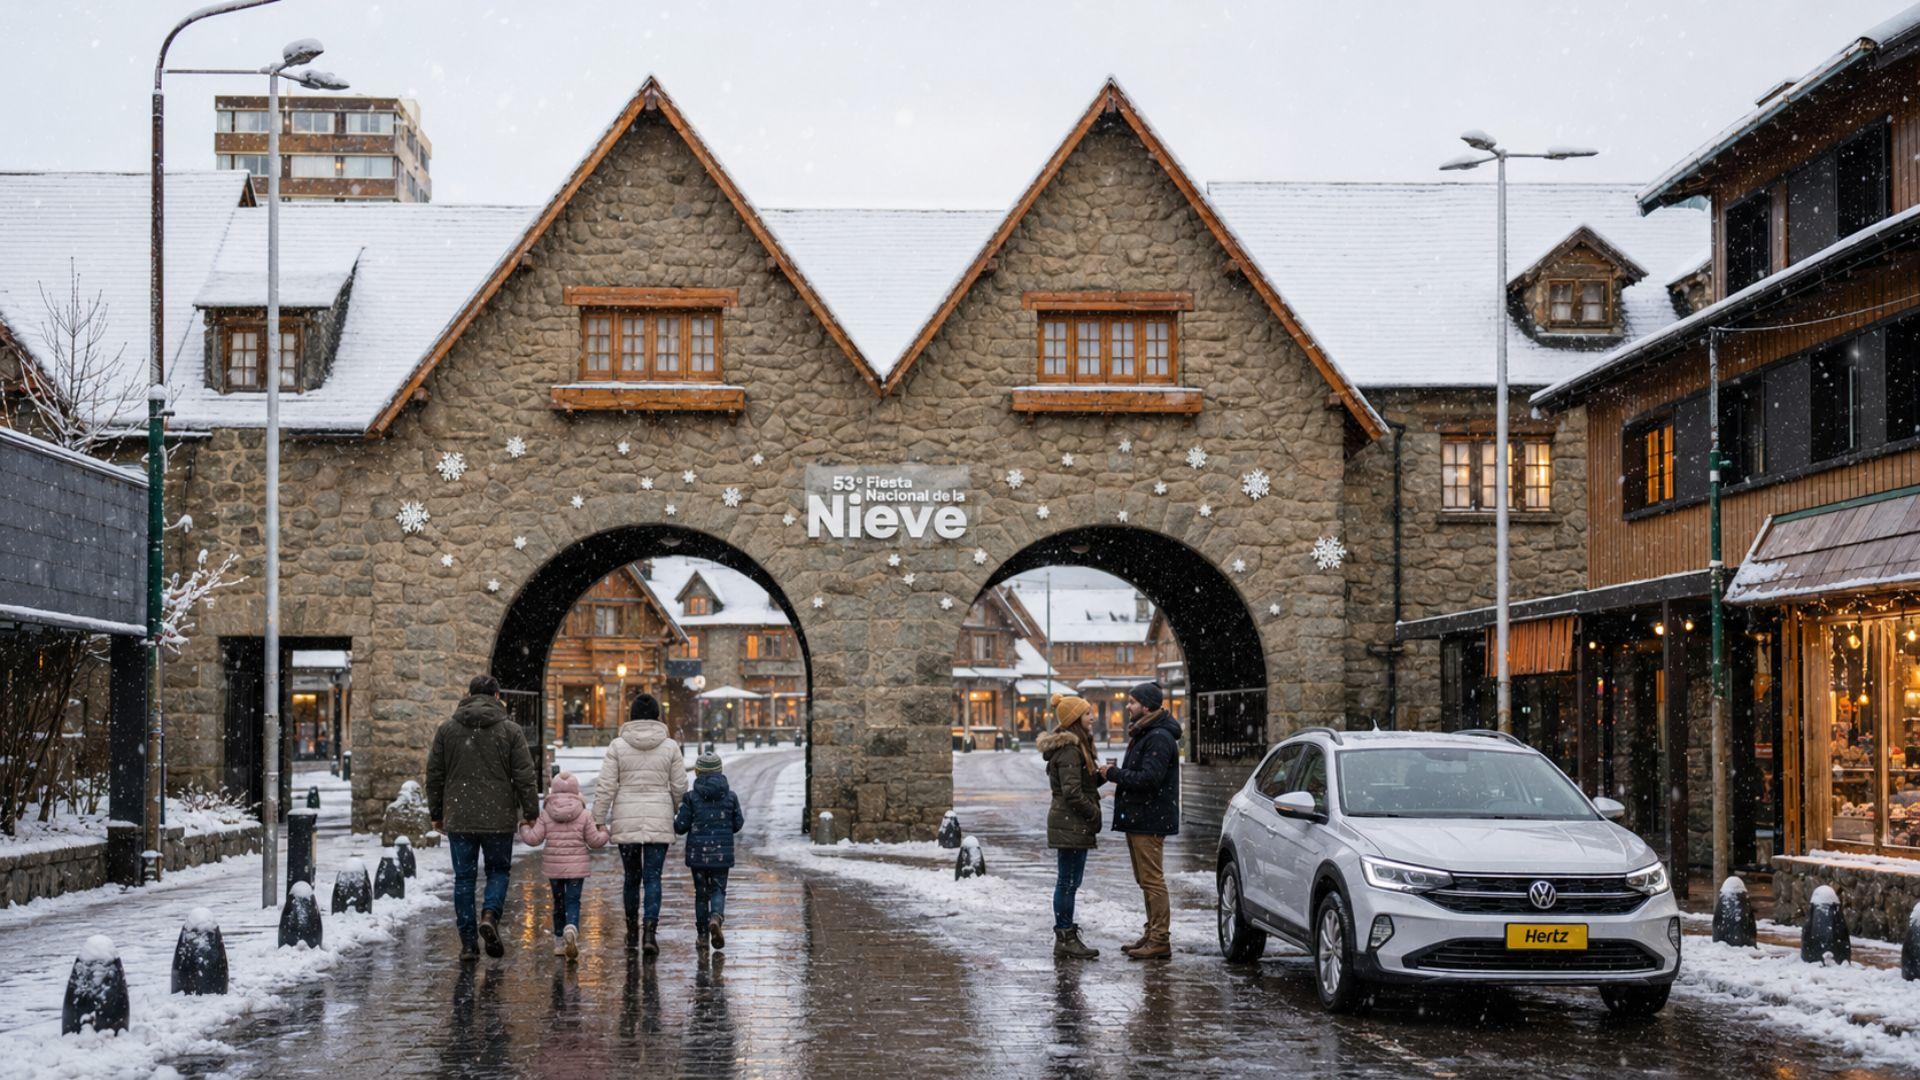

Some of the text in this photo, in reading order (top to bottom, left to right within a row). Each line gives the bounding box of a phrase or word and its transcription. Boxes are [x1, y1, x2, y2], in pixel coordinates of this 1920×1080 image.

[866, 476, 912, 489] Fiesta
[866, 489, 965, 502] Nacional de la
[808, 492, 967, 539] Nieve
[1525, 928, 1569, 943] Hertz
